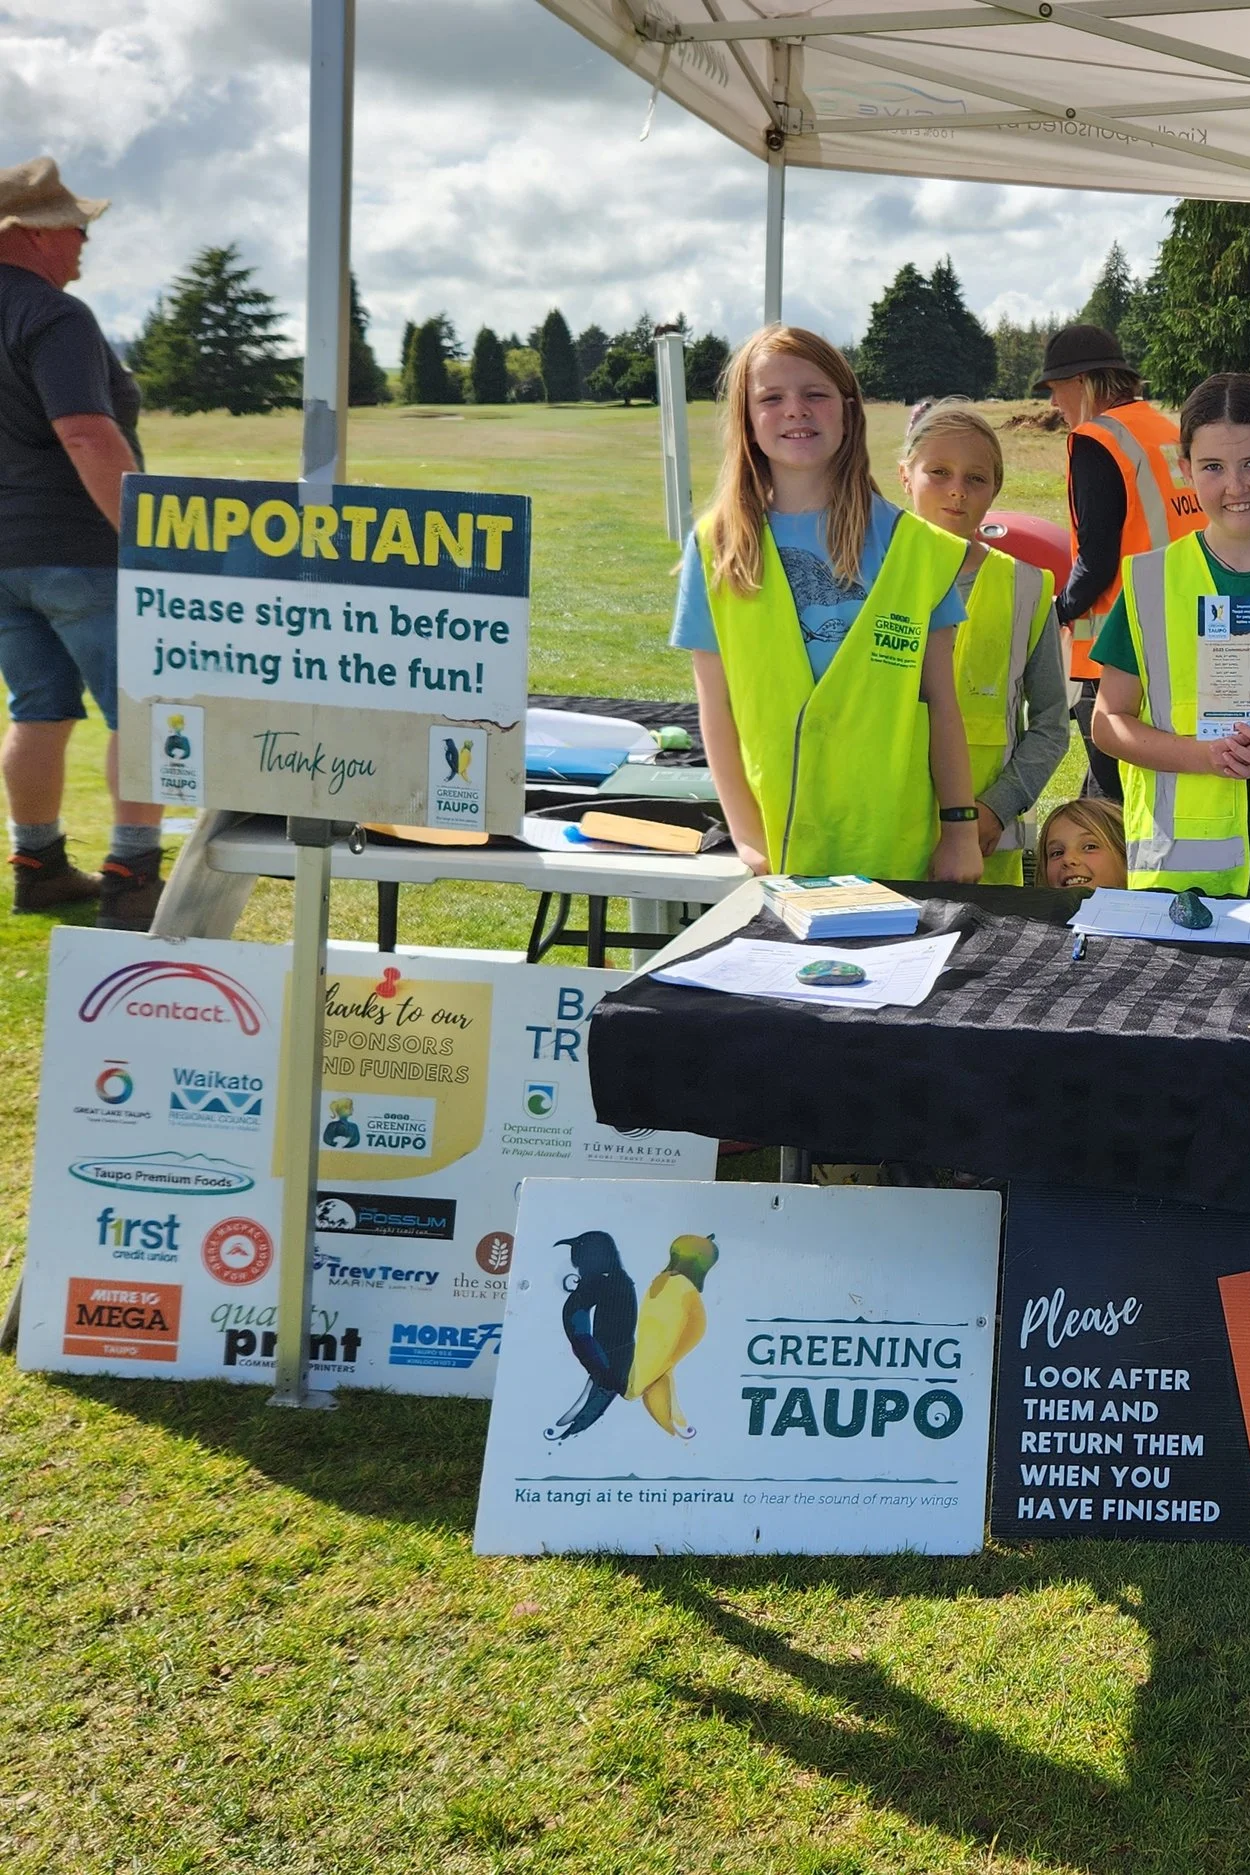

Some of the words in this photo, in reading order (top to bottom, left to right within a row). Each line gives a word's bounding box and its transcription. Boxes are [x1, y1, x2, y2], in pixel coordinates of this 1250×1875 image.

[137, 493, 513, 571] IMPORTANT
[134, 586, 245, 623] Please
[255, 595, 331, 637] sign
[343, 602, 378, 634] in
[389, 605, 510, 644] before
[875, 619, 922, 636] GREENING
[153, 640, 281, 684] joining
[293, 646, 328, 680] in
[339, 653, 397, 687] the
[409, 657, 485, 693] fun!
[254, 730, 328, 782] Thank
[330, 757, 377, 794] you
[126, 1001, 224, 1023] contact
[324, 982, 391, 1026] hanks
[397, 996, 425, 1026] to
[431, 1008, 473, 1030] our
[321, 1028, 454, 1056] SPONSORS
[172, 1067, 263, 1092] Waikato
[322, 1056, 355, 1075] ND
[359, 1058, 470, 1084] FUNDERS
[73, 1106, 101, 1116] GREAT
[102, 1108, 124, 1117] LAKE
[169, 1111, 217, 1124] REGIONAL
[218, 1113, 260, 1125] COUNCIL
[367, 1120, 427, 1133] GREENING
[503, 1122, 562, 1135] Department
[563, 1126, 573, 1135] of
[501, 1134, 572, 1148] Conservation
[93, 1167, 132, 1182] Taupo
[135, 1170, 192, 1185] Premium
[194, 1175, 233, 1188] Foods
[359, 1212, 447, 1228] POSSUM
[113, 1250, 145, 1261] credit
[146, 1252, 178, 1263] union
[327, 1262, 377, 1280] Trev
[378, 1266, 440, 1286] Terry
[328, 1278, 385, 1289] MARINE
[453, 1272, 479, 1288] the
[484, 1279, 508, 1290] sou
[90, 1288, 139, 1304] MITRE
[453, 1290, 487, 1299] BULK
[75, 1303, 169, 1331] MEGA
[1019, 1287, 1143, 1350] Please
[223, 1327, 362, 1366] prnt
[391, 1323, 477, 1347] MORE
[103, 1345, 138, 1356] TAUPO
[746, 1333, 962, 1369] GREENING
[307, 1362, 355, 1373] PRINTERS
[1024, 1366, 1101, 1388] LOOK
[1108, 1368, 1190, 1390] AFTER
[1024, 1399, 1094, 1421] THEM
[1100, 1401, 1158, 1422] AND
[1021, 1431, 1122, 1454] RETURN
[1133, 1434, 1203, 1456] THEM
[1020, 1464, 1099, 1486] WHEN
[1111, 1466, 1170, 1488] YOU
[515, 1489, 541, 1502] Kia
[547, 1489, 591, 1506] tangi
[596, 1489, 611, 1502] ai
[617, 1490, 633, 1502] te
[639, 1489, 667, 1502] tini
[673, 1489, 734, 1506] parirau
[743, 1490, 757, 1504] to
[760, 1489, 790, 1505] hear
[792, 1490, 815, 1505] the
[817, 1490, 860, 1506] sound
[863, 1490, 878, 1507] of
[879, 1494, 917, 1510] many
[920, 1492, 959, 1511] wings
[1018, 1497, 1092, 1519] HAVE
[1103, 1499, 1220, 1522] FINISHED
